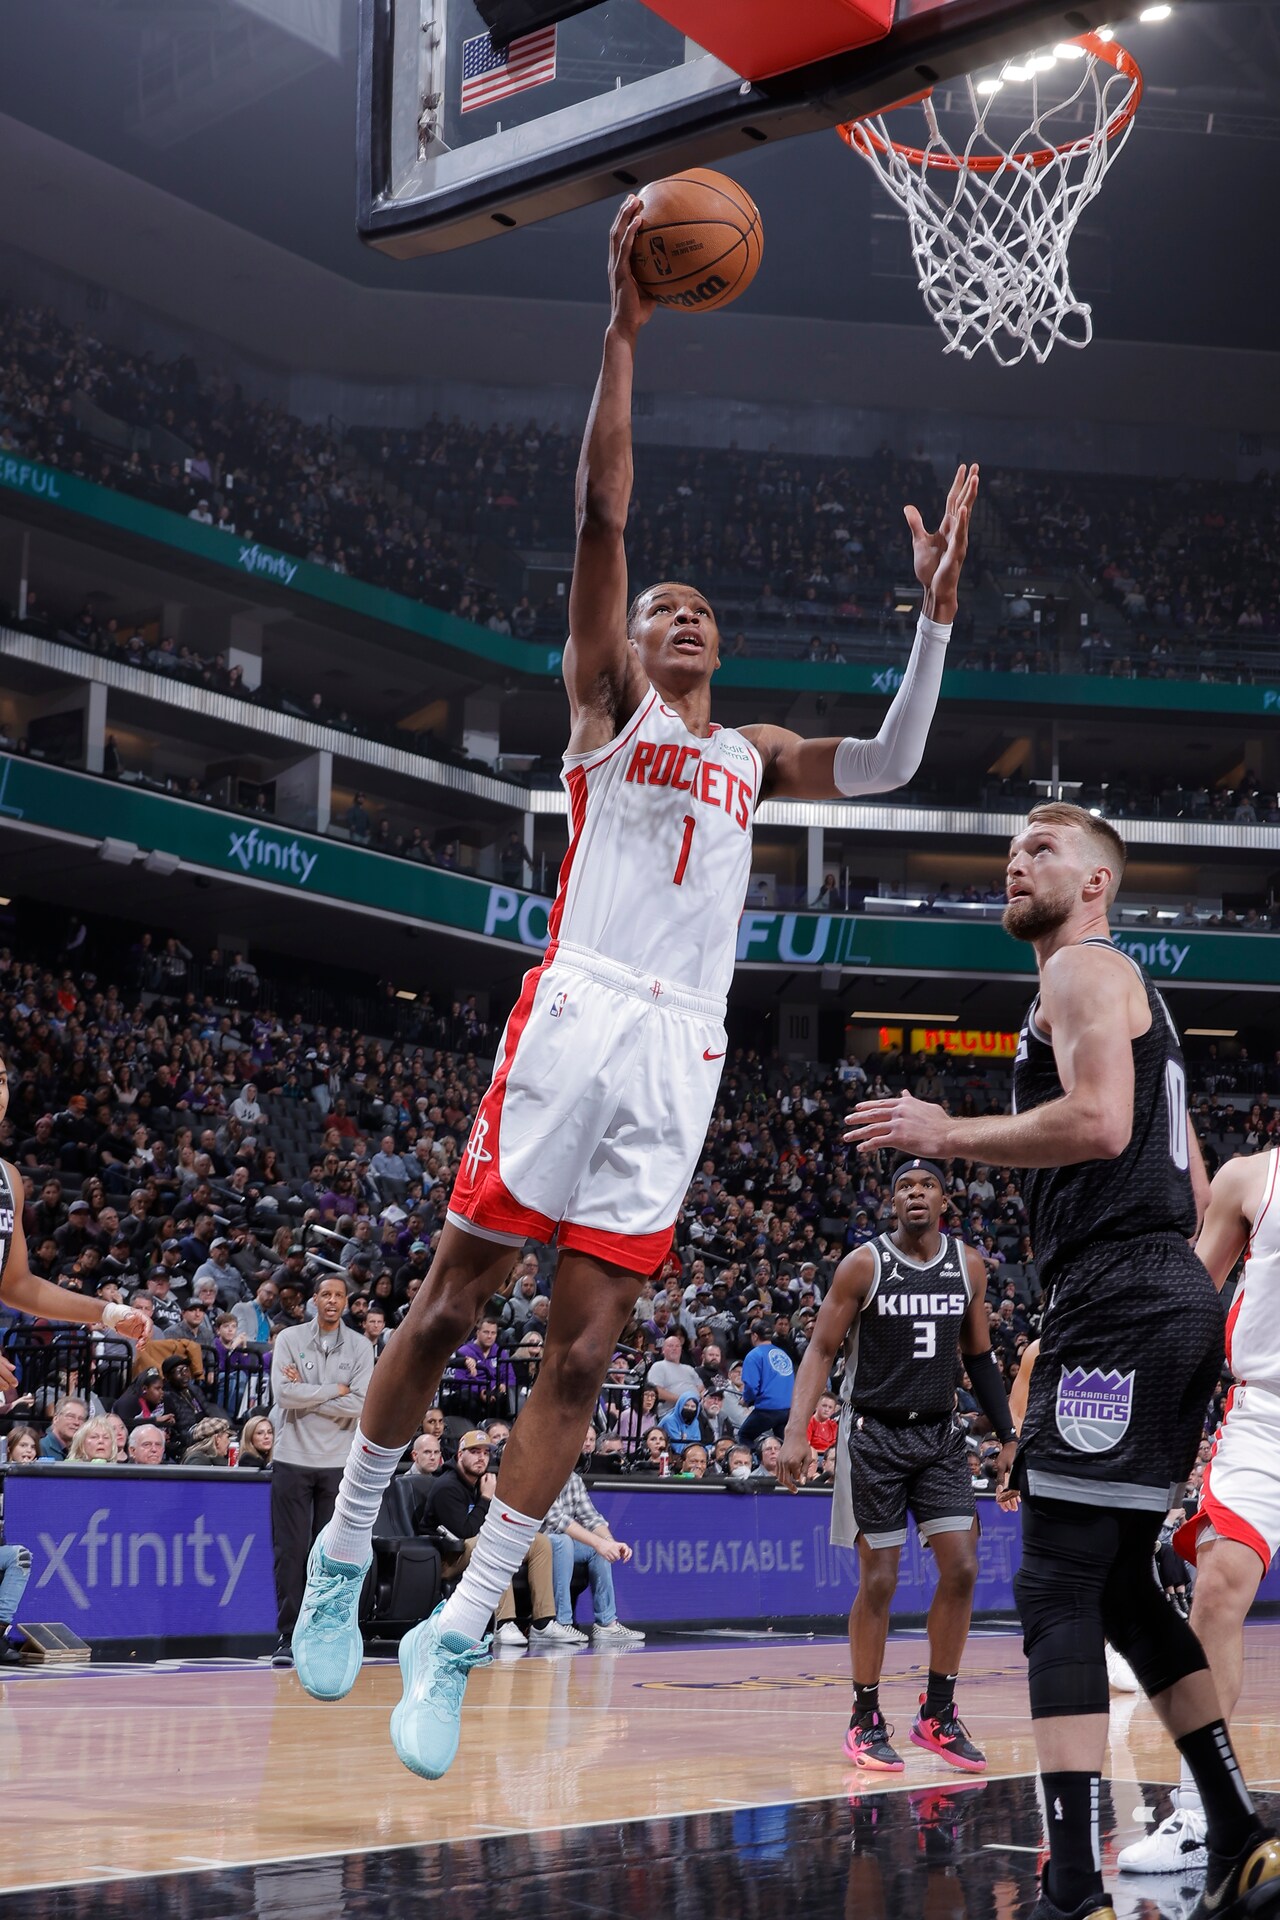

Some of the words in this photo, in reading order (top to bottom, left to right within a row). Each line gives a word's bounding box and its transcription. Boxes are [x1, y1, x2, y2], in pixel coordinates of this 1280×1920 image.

[238, 544, 298, 584] xfinity
[228, 828, 318, 883] xfinity
[672, 814, 696, 886] 1
[789, 1015, 810, 1040] 110
[882, 1251, 891, 1262] 6
[878, 1294, 966, 1316] KINGS
[912, 1321, 936, 1359] 3
[1058, 1400, 1129, 1422] KINGS
[1062, 1389, 1128, 1403] SACRAMENTO
[35, 1508, 256, 1610] xfinity
[633, 1539, 805, 1574] UNBEATABLE
